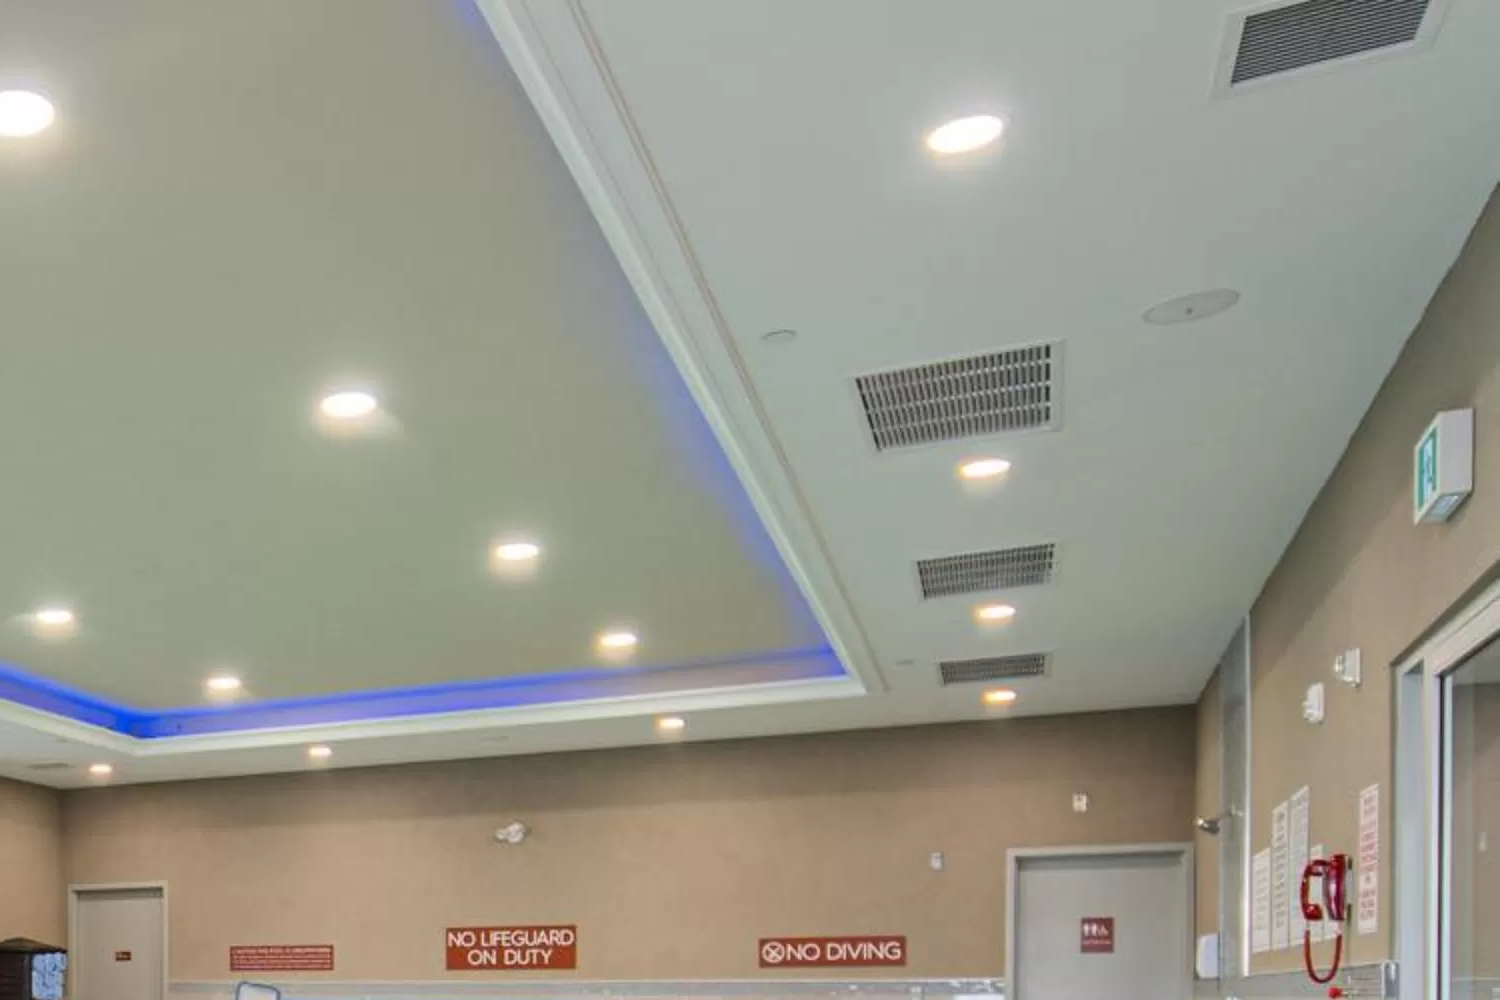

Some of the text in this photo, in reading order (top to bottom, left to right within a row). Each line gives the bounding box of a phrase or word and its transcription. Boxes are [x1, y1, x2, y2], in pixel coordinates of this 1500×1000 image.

[447, 929, 575, 947] NO LIFEGUARD
[467, 948, 553, 966] ON DUTY
[787, 941, 902, 961] NO DIVING
